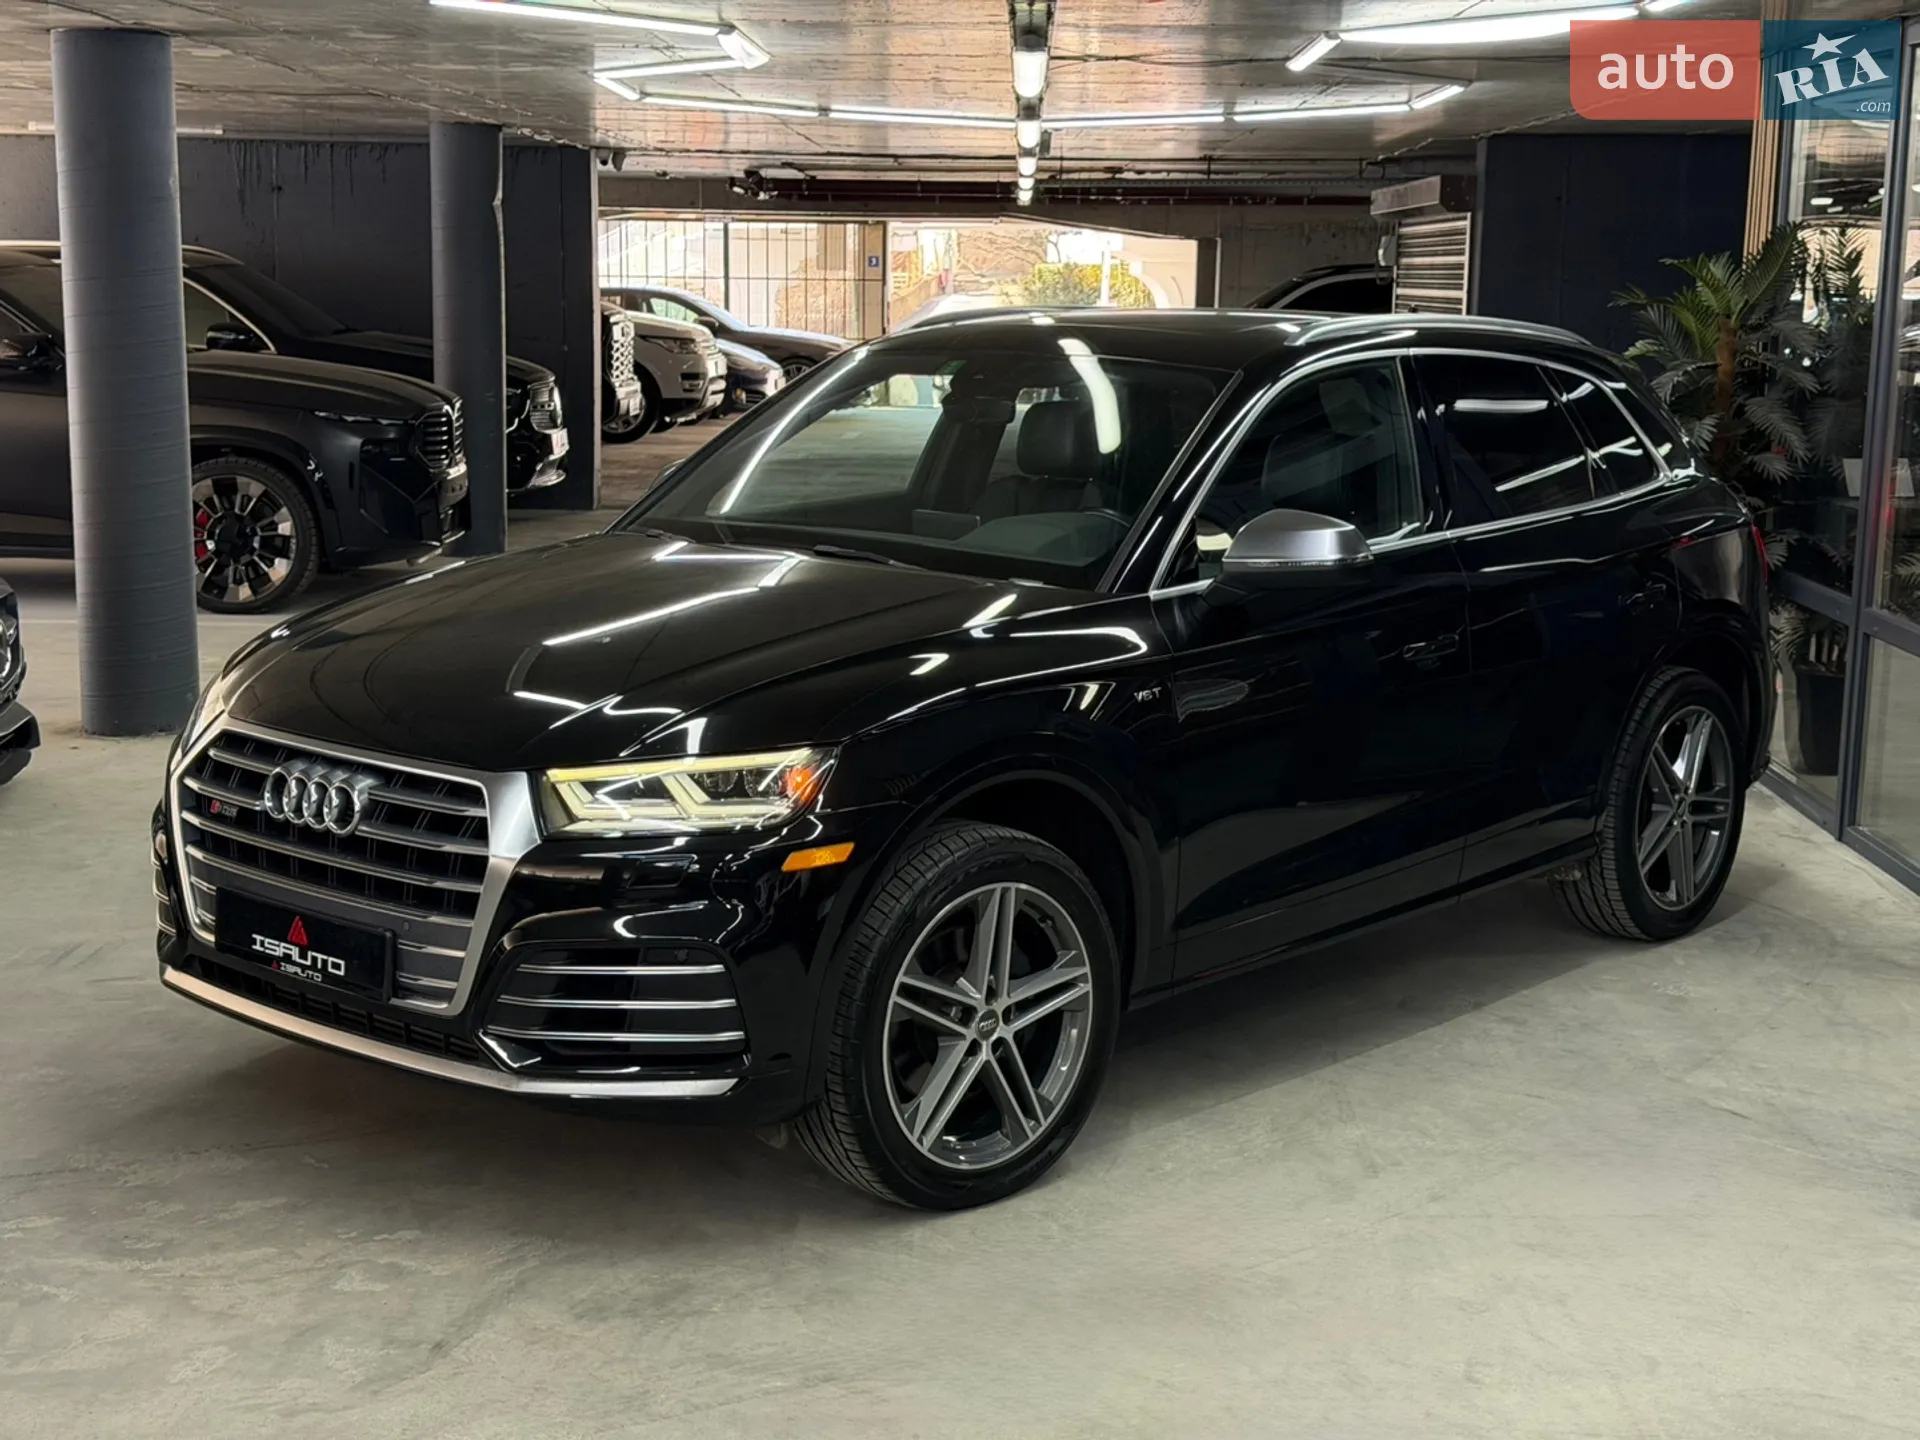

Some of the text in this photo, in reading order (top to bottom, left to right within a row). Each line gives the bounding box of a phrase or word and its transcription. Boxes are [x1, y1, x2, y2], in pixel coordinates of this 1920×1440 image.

[1133, 686, 1162, 703] V6T
[252, 933, 345, 976] ISAUTO
[280, 962, 322, 982] ISAUTO
